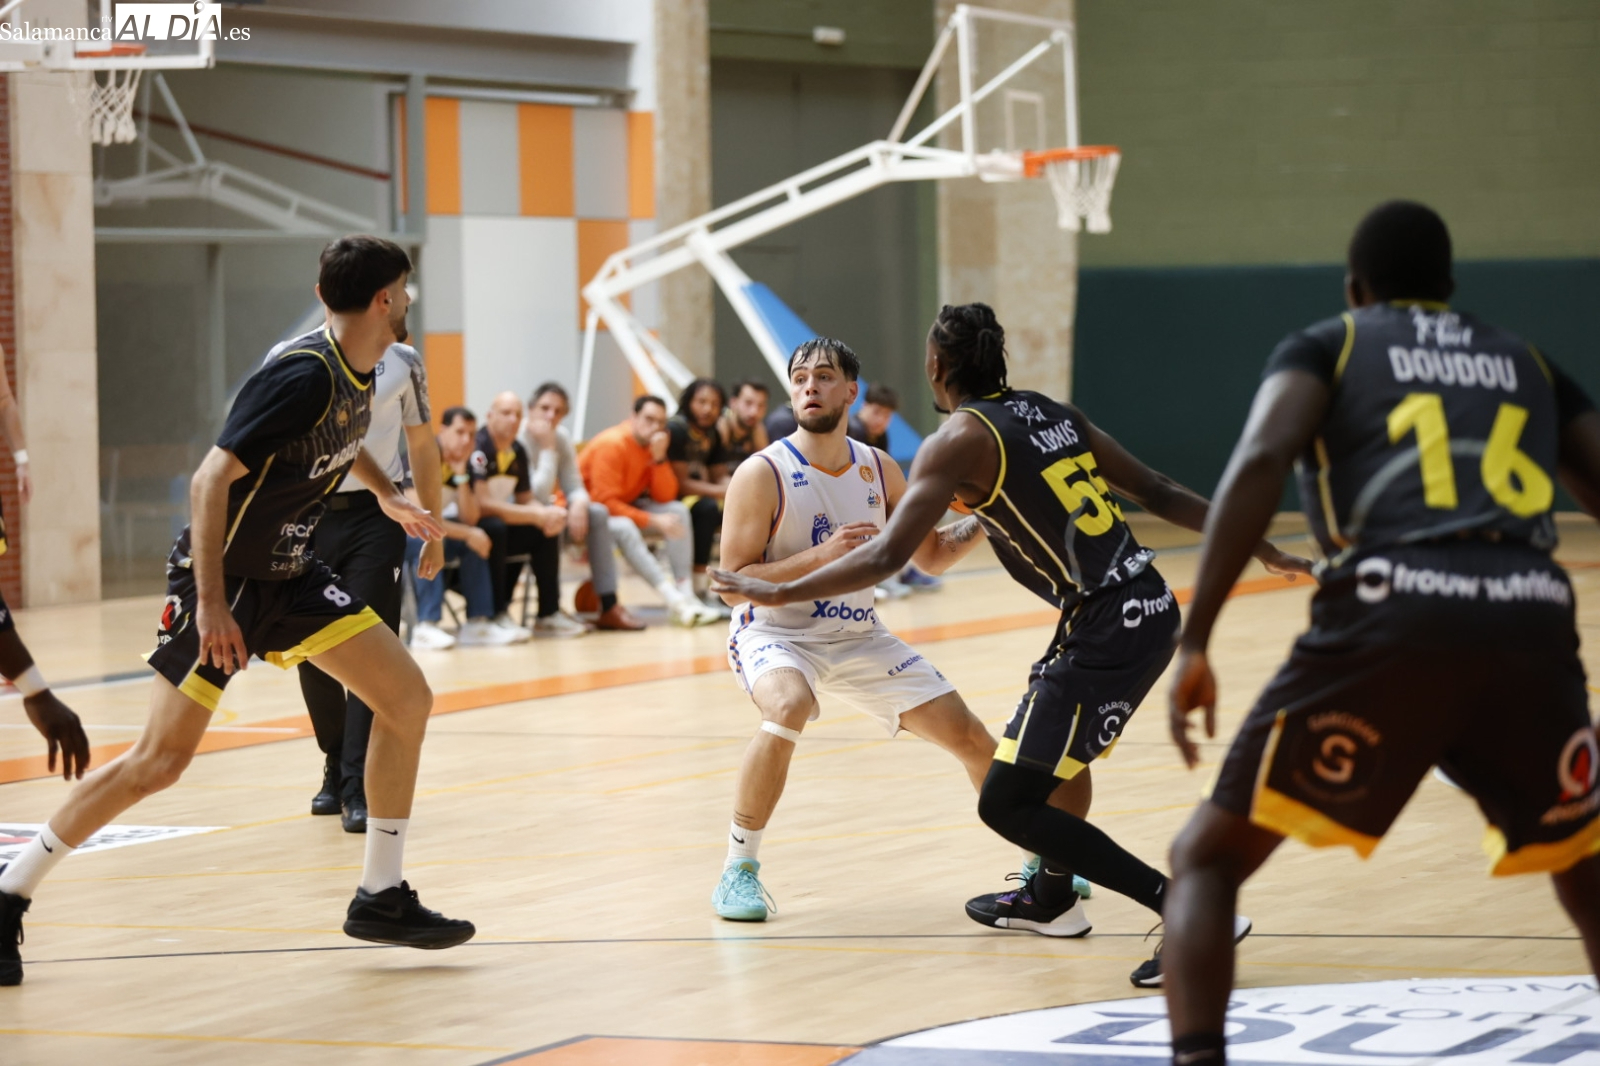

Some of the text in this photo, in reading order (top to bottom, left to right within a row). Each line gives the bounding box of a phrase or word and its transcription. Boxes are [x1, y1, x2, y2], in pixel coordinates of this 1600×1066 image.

[1389, 346, 1518, 393] DOUDOU
[1386, 393, 1555, 518] 16
[323, 584, 352, 607] 8
